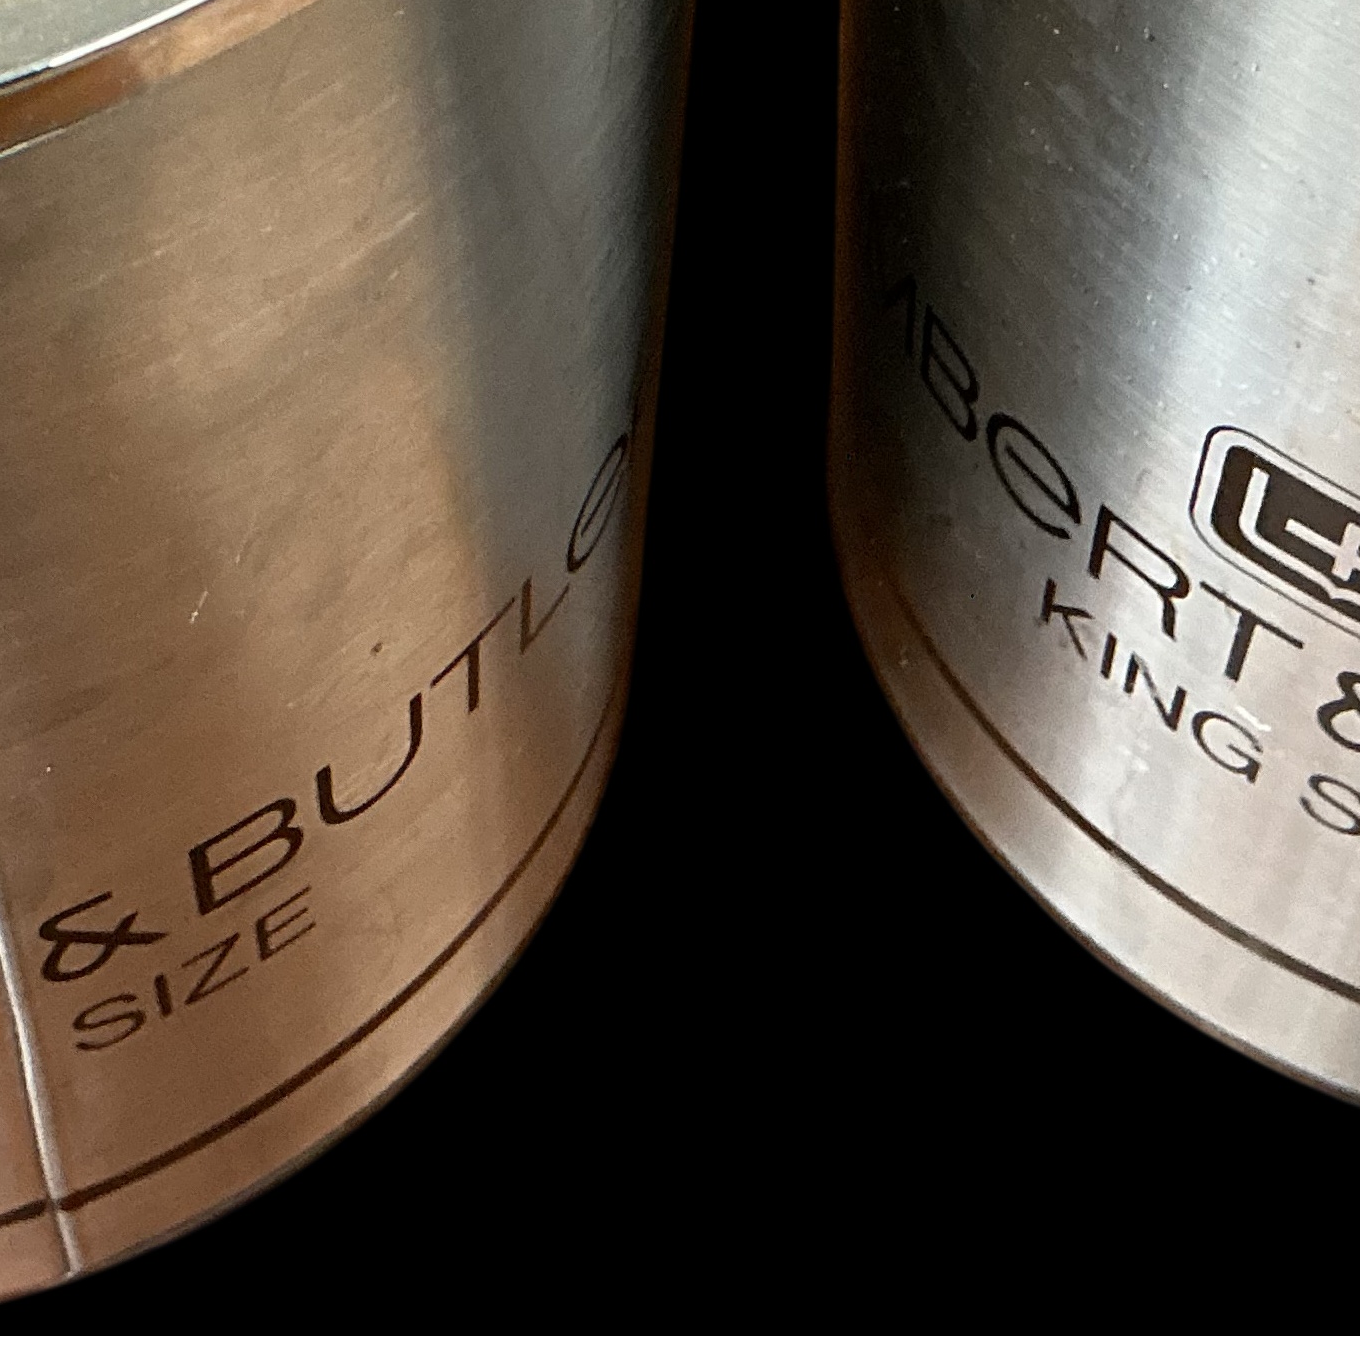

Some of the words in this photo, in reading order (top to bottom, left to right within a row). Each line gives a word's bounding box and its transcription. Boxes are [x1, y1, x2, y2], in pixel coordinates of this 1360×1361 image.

[884, 274, 1304, 682] BeRT
[40, 892, 167, 982] &
[187, 432, 629, 916] BUTLe
[1040, 579, 1264, 783] KING
[71, 886, 317, 1051] SIZE
